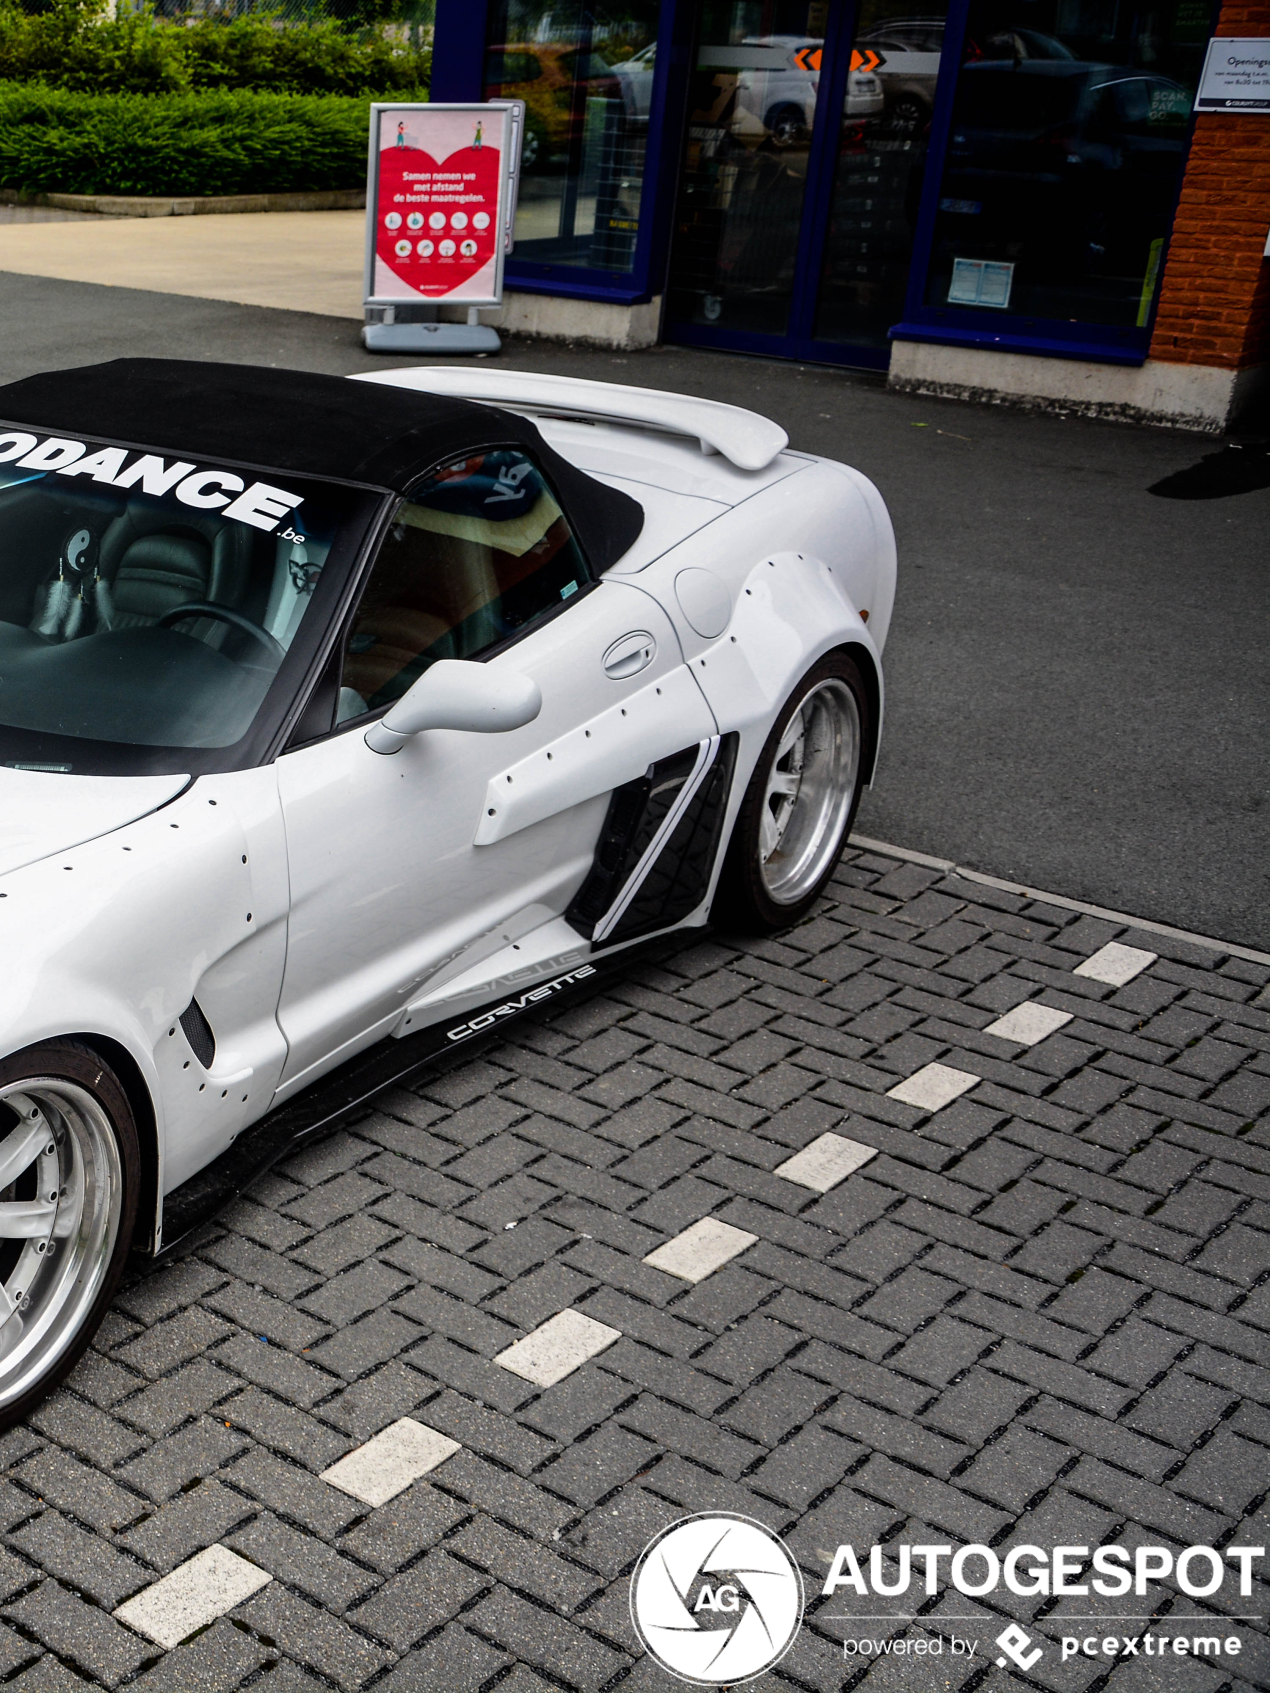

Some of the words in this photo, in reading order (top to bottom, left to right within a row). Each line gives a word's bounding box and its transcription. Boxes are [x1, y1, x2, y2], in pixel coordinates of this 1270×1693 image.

[402, 171, 431, 181] Samen
[432, 172, 461, 181] nemen
[462, 172, 476, 181] we
[413, 183, 431, 191] met
[432, 182, 464, 192] afstand
[393, 193, 405, 203] de
[406, 193, 430, 203] beste
[431, 193, 485, 205] maatregelen.
[446, 964, 597, 1041] CORVETTE
